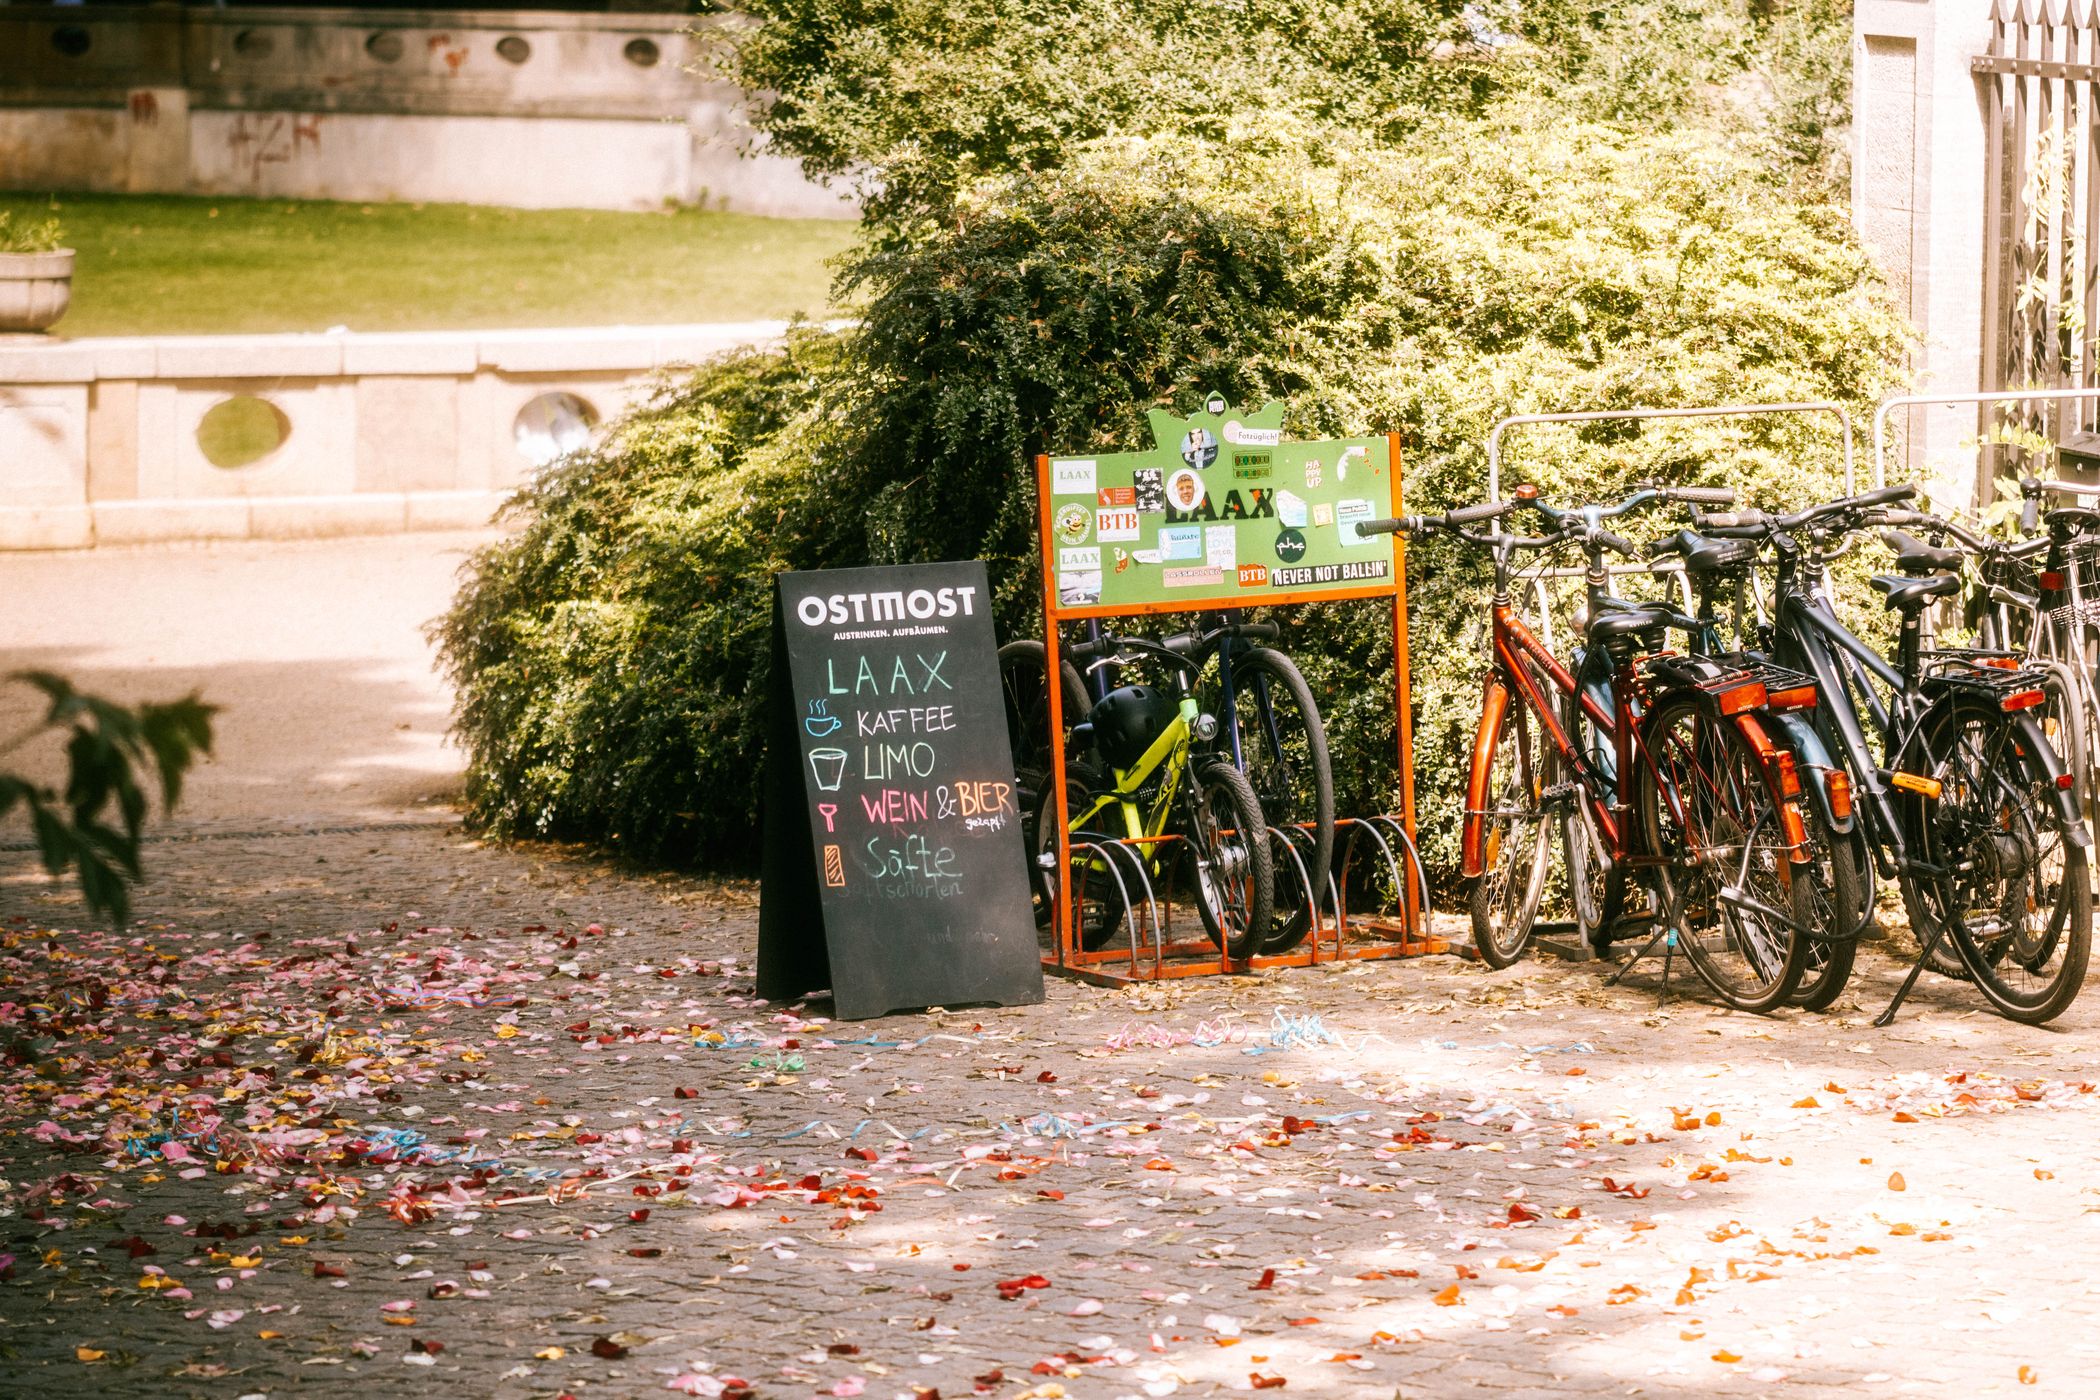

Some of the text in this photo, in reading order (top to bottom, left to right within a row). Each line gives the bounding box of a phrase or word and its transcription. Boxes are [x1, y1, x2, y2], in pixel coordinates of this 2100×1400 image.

[1238, 431, 1277, 442] Fotzüglich!
[1060, 470, 1091, 480] LAAX
[1099, 513, 1138, 531] BTB
[1061, 553, 1099, 565] LAAX
[1239, 568, 1267, 582] BTB
[1274, 561, 1387, 585] NEVER NOT BALLIN'
[797, 586, 976, 626] OSTMOST
[833, 625, 949, 641] AUSTRINKEN. AUFBÄUMEN.
[827, 650, 953, 696] LAAX
[857, 705, 957, 737] KAFFEE
[864, 742, 935, 780] LIMO
[861, 781, 1014, 824] WEIN & BIER
